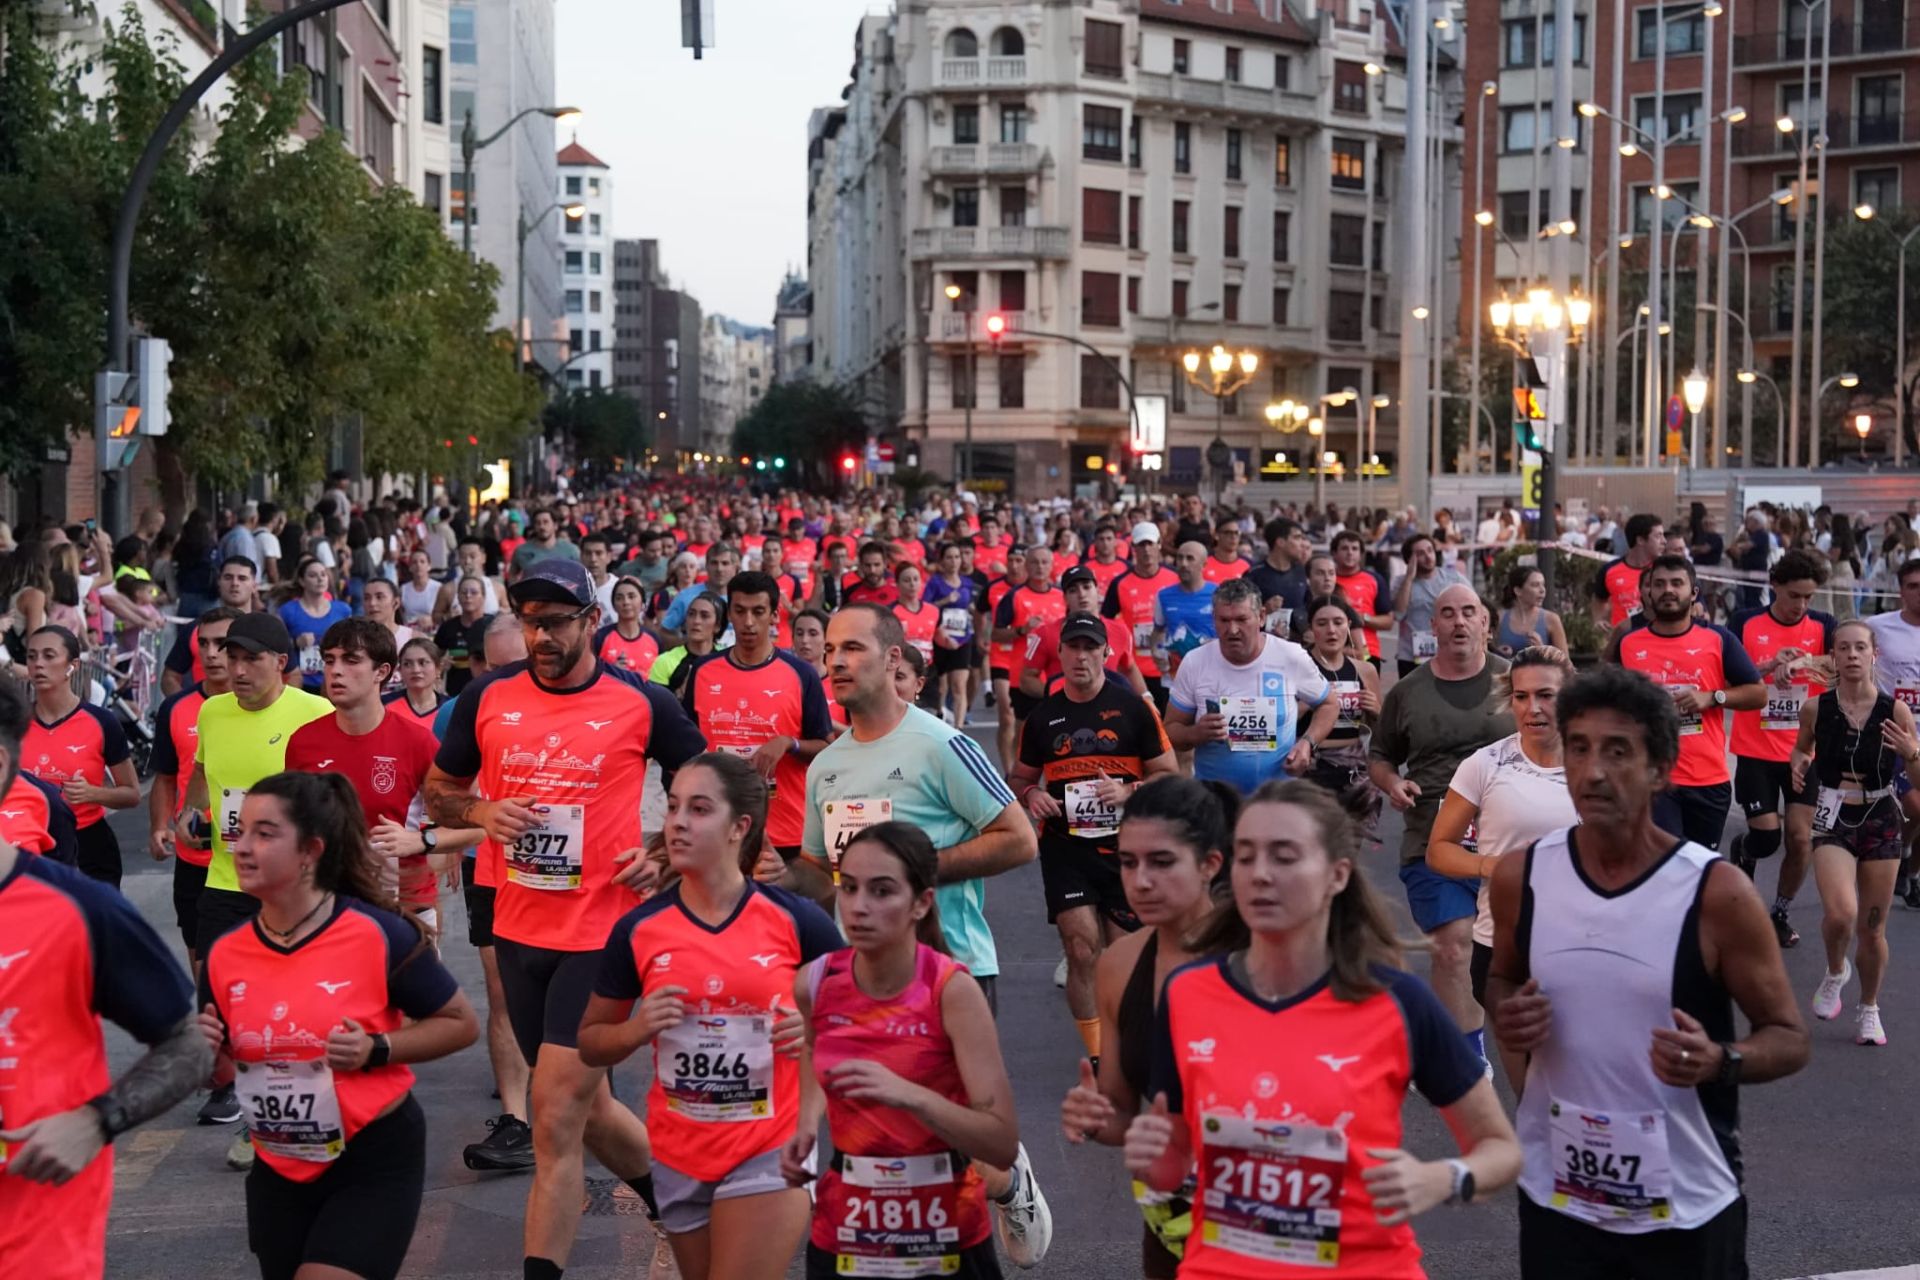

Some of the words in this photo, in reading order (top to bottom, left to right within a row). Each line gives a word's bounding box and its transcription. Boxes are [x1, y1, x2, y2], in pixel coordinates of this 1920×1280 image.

[1768, 700, 1800, 711] 5481
[1228, 715, 1267, 729] 4256
[512, 833, 568, 855] 3377
[674, 1052, 749, 1079] 3846
[252, 1093, 315, 1120] 3847
[1565, 1144, 1641, 1183] 3847
[1213, 1156, 1332, 1209] 21512
[844, 1197, 947, 1230] 21816
